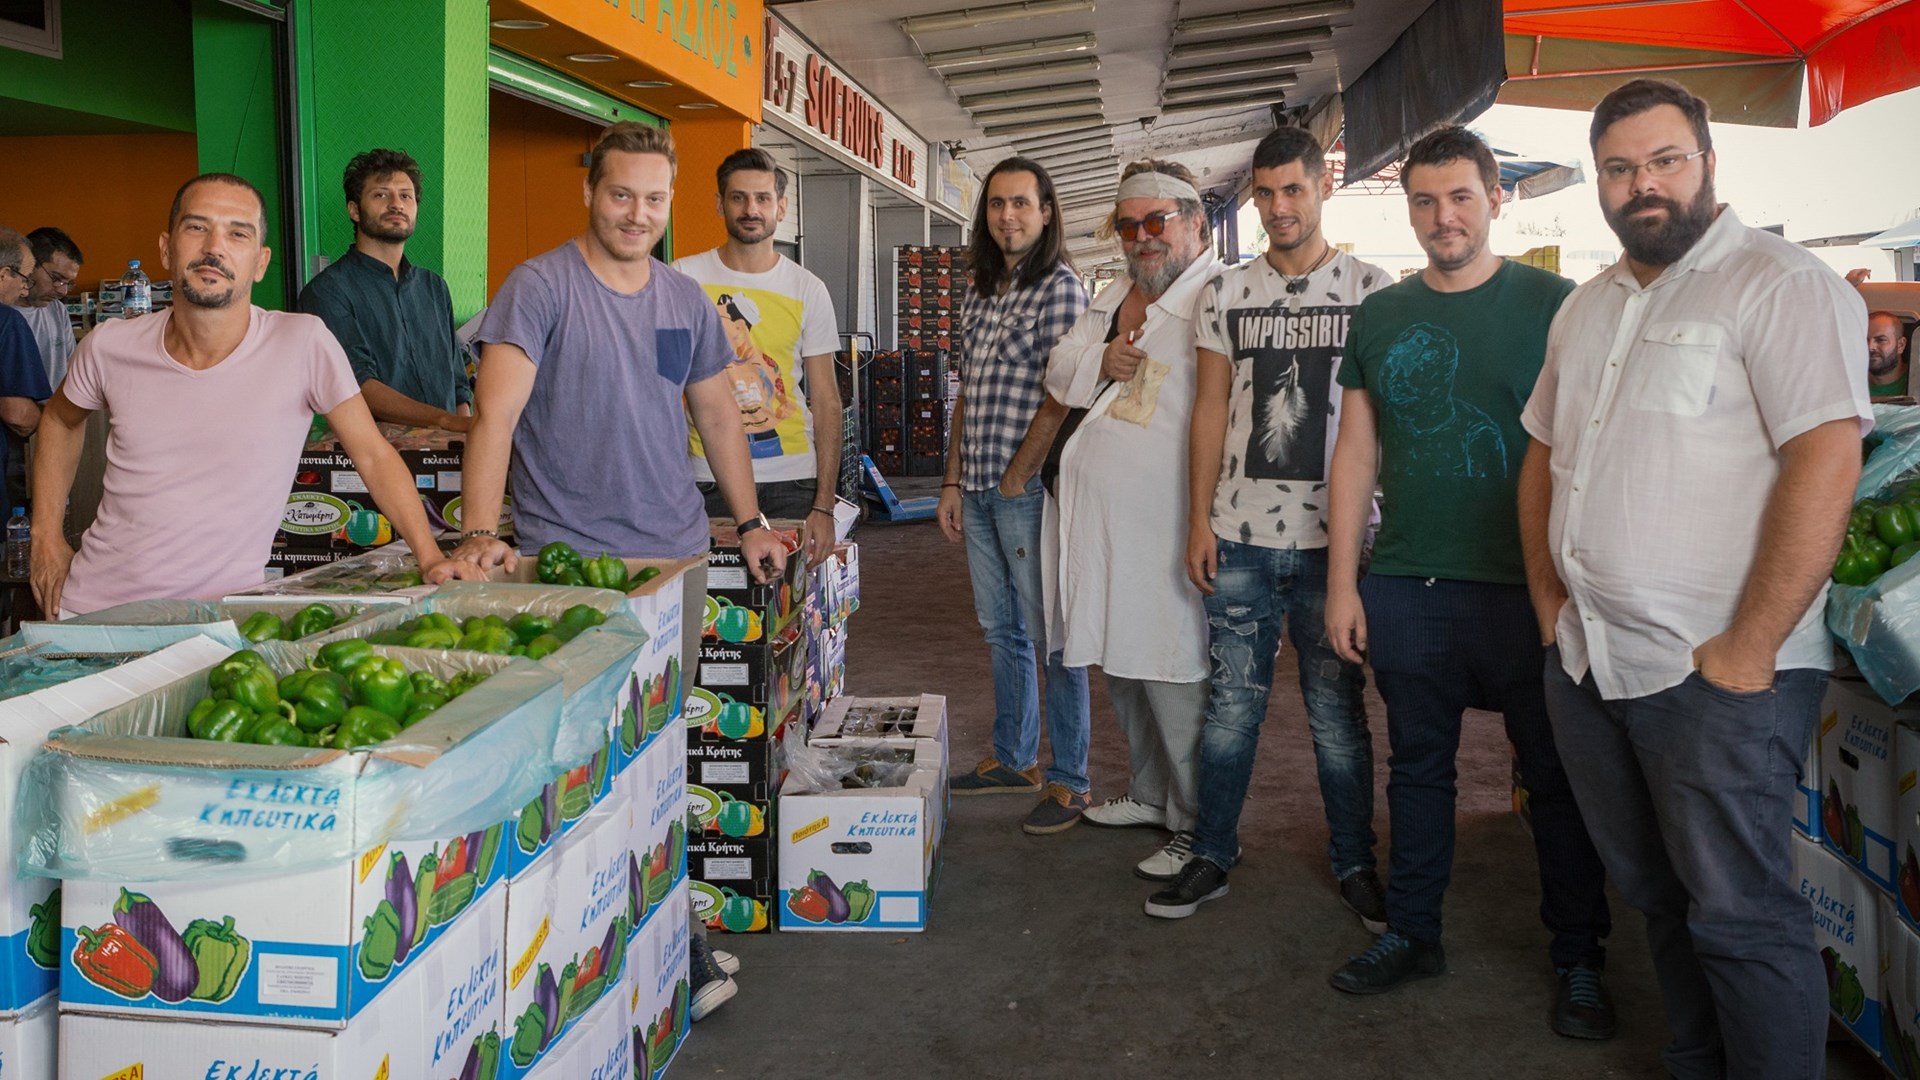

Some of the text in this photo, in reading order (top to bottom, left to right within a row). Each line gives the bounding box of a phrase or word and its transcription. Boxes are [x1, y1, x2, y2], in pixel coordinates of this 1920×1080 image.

[804, 53, 884, 169] SOFRUITS
[1238, 314, 1351, 350] IMPOSSIBLE
[422, 455, 460, 465] εκλεκτά
[284, 552, 332, 564] κηπευτικά
[705, 647, 742, 660] Κρήτης
[706, 745, 743, 758] Κρήτης
[861, 810, 918, 825] Εκλεκτά
[846, 824, 916, 837] Κηπευτικά
[708, 841, 745, 855] Κρήτης
[1800, 878, 1856, 928] Εκλεκτά
[1814, 911, 1855, 946] ευτικά
